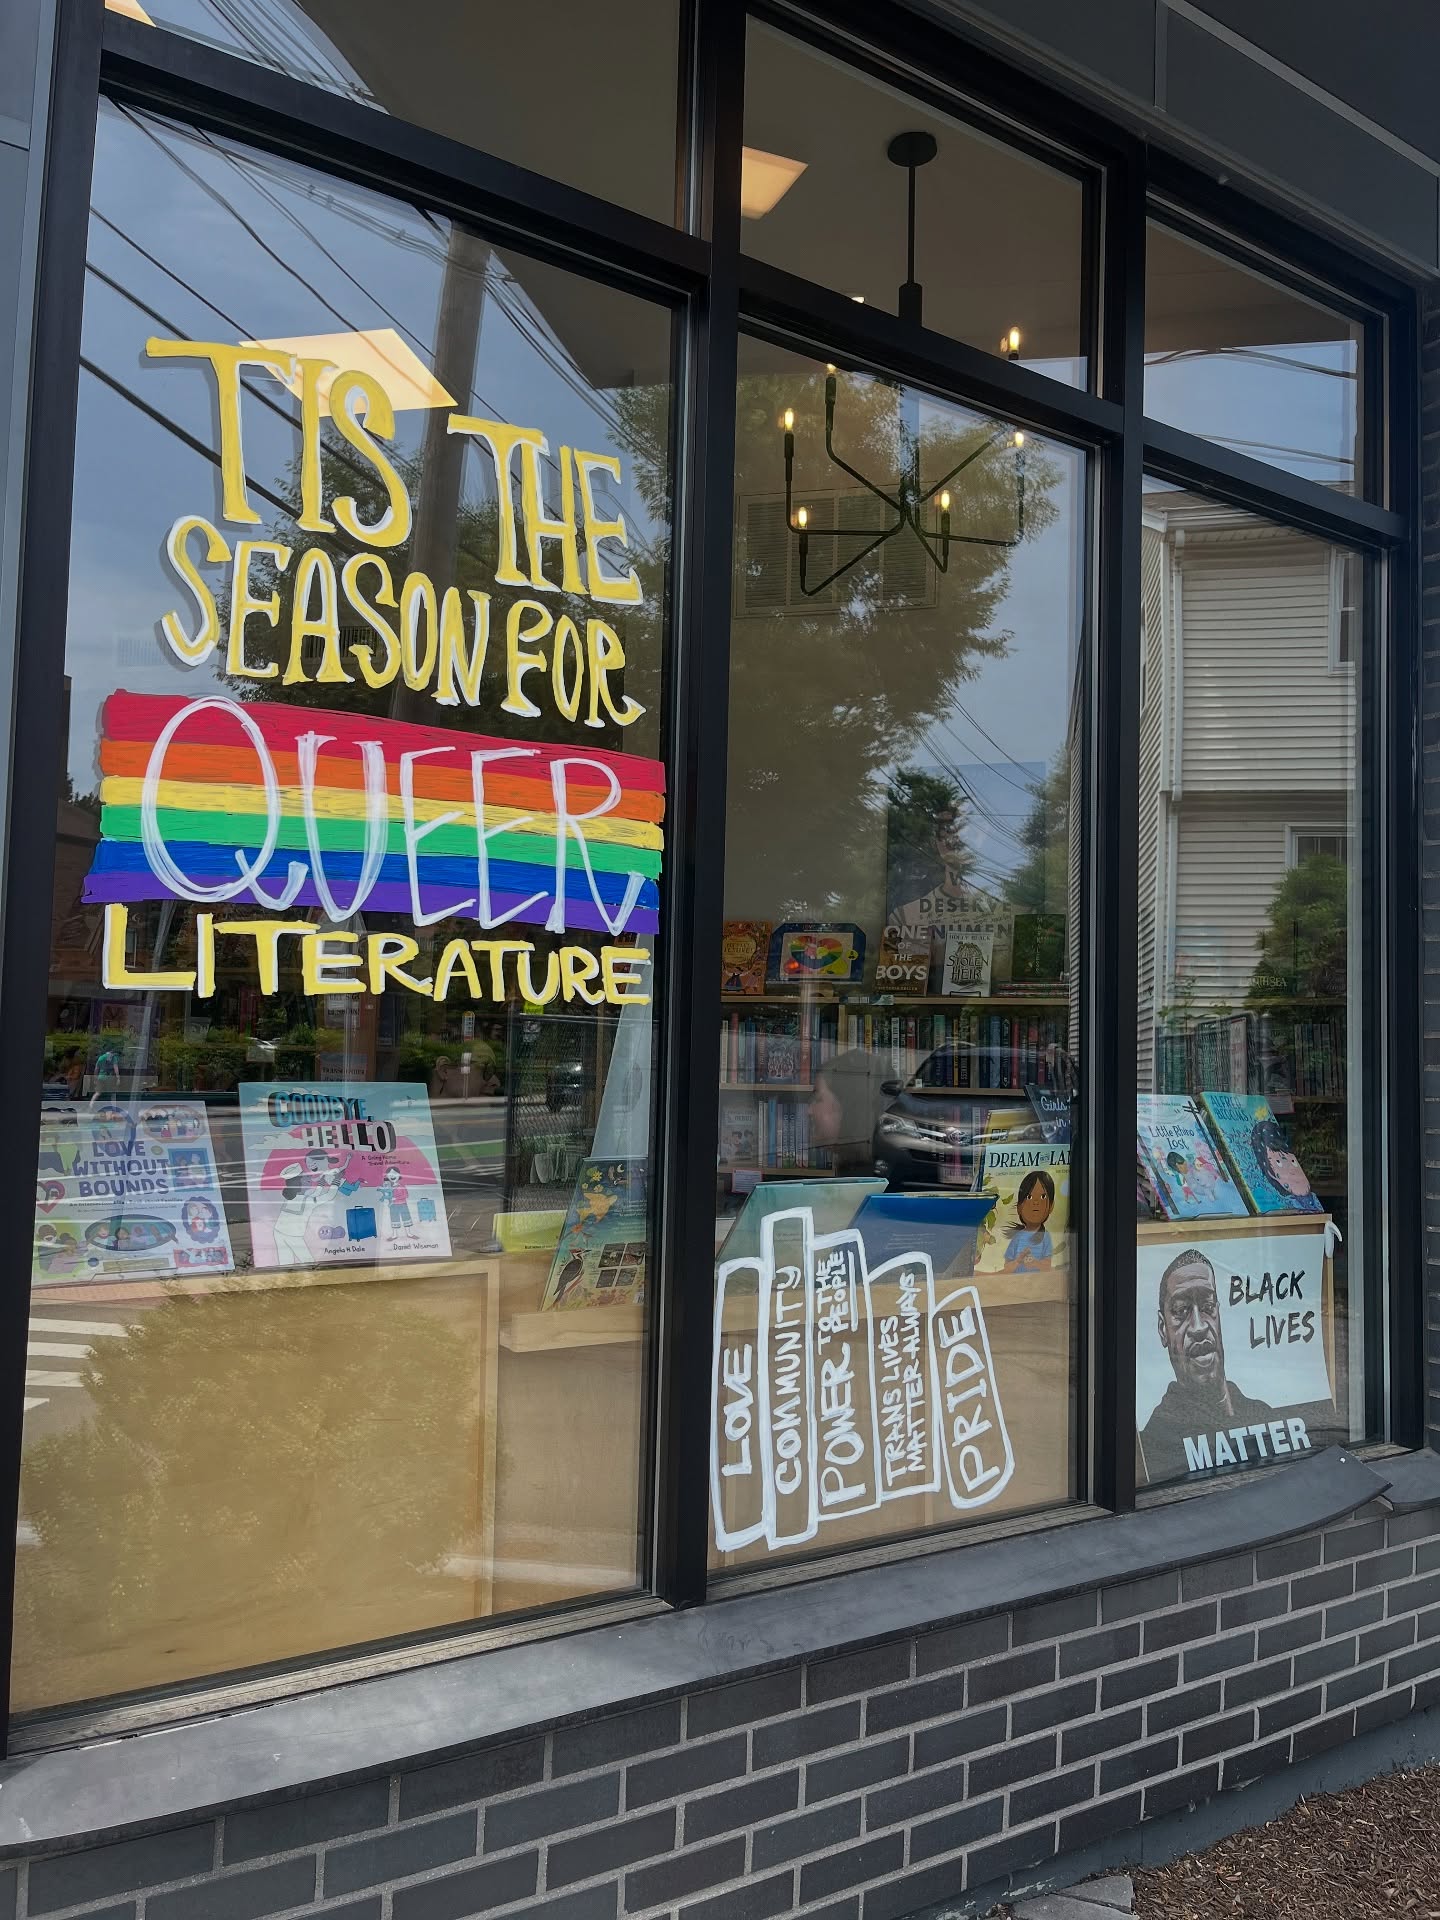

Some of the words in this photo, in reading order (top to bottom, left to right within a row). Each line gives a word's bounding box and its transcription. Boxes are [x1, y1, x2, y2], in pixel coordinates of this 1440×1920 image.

[146, 337, 411, 547] TIS
[447, 413, 644, 604] THE
[161, 516, 491, 706] SEASON
[501, 599, 646, 728] FOR
[141, 695, 646, 937] QUEER
[919, 897, 1012, 913] DESERVE
[884, 925, 928, 939] ONE
[897, 942, 911, 950] OF
[102, 903, 651, 1005] LITERATURE
[876, 965, 927, 980] BOYS
[893, 953, 912, 962] THE
[946, 955, 989, 967] STOLEN
[951, 966, 983, 980] HEIR
[1210, 1095, 1241, 1107] ALFRED
[92, 1140, 146, 1157] LOVE
[302, 1121, 395, 1154] HELLO
[1148, 1125, 1173, 1138] Little
[1173, 1125, 1194, 1138] Rhino
[1167, 1138, 1190, 1150] Lost
[72, 1159, 169, 1176] WITHOUT
[989, 1151, 1041, 1168] DREAM
[79, 1178, 169, 1197] BOUNDS
[816, 1258, 832, 1313] THE
[828, 1250, 849, 1333] PEOPLE
[1228, 1269, 1306, 1307] BLACK
[896, 1272, 923, 1359] ALWAYS
[1249, 1311, 1315, 1349] LIVES
[818, 1319, 832, 1354] TO
[879, 1316, 902, 1381] LIVES
[772, 1266, 803, 1495] COMMUNITY
[939, 1305, 1000, 1492] PRIDE
[722, 1344, 754, 1477] LOVE
[820, 1342, 866, 1507] POWER
[902, 1360, 928, 1473] MATTER
[881, 1388, 907, 1487] TRANS
[1183, 1417, 1312, 1472] MATTER
